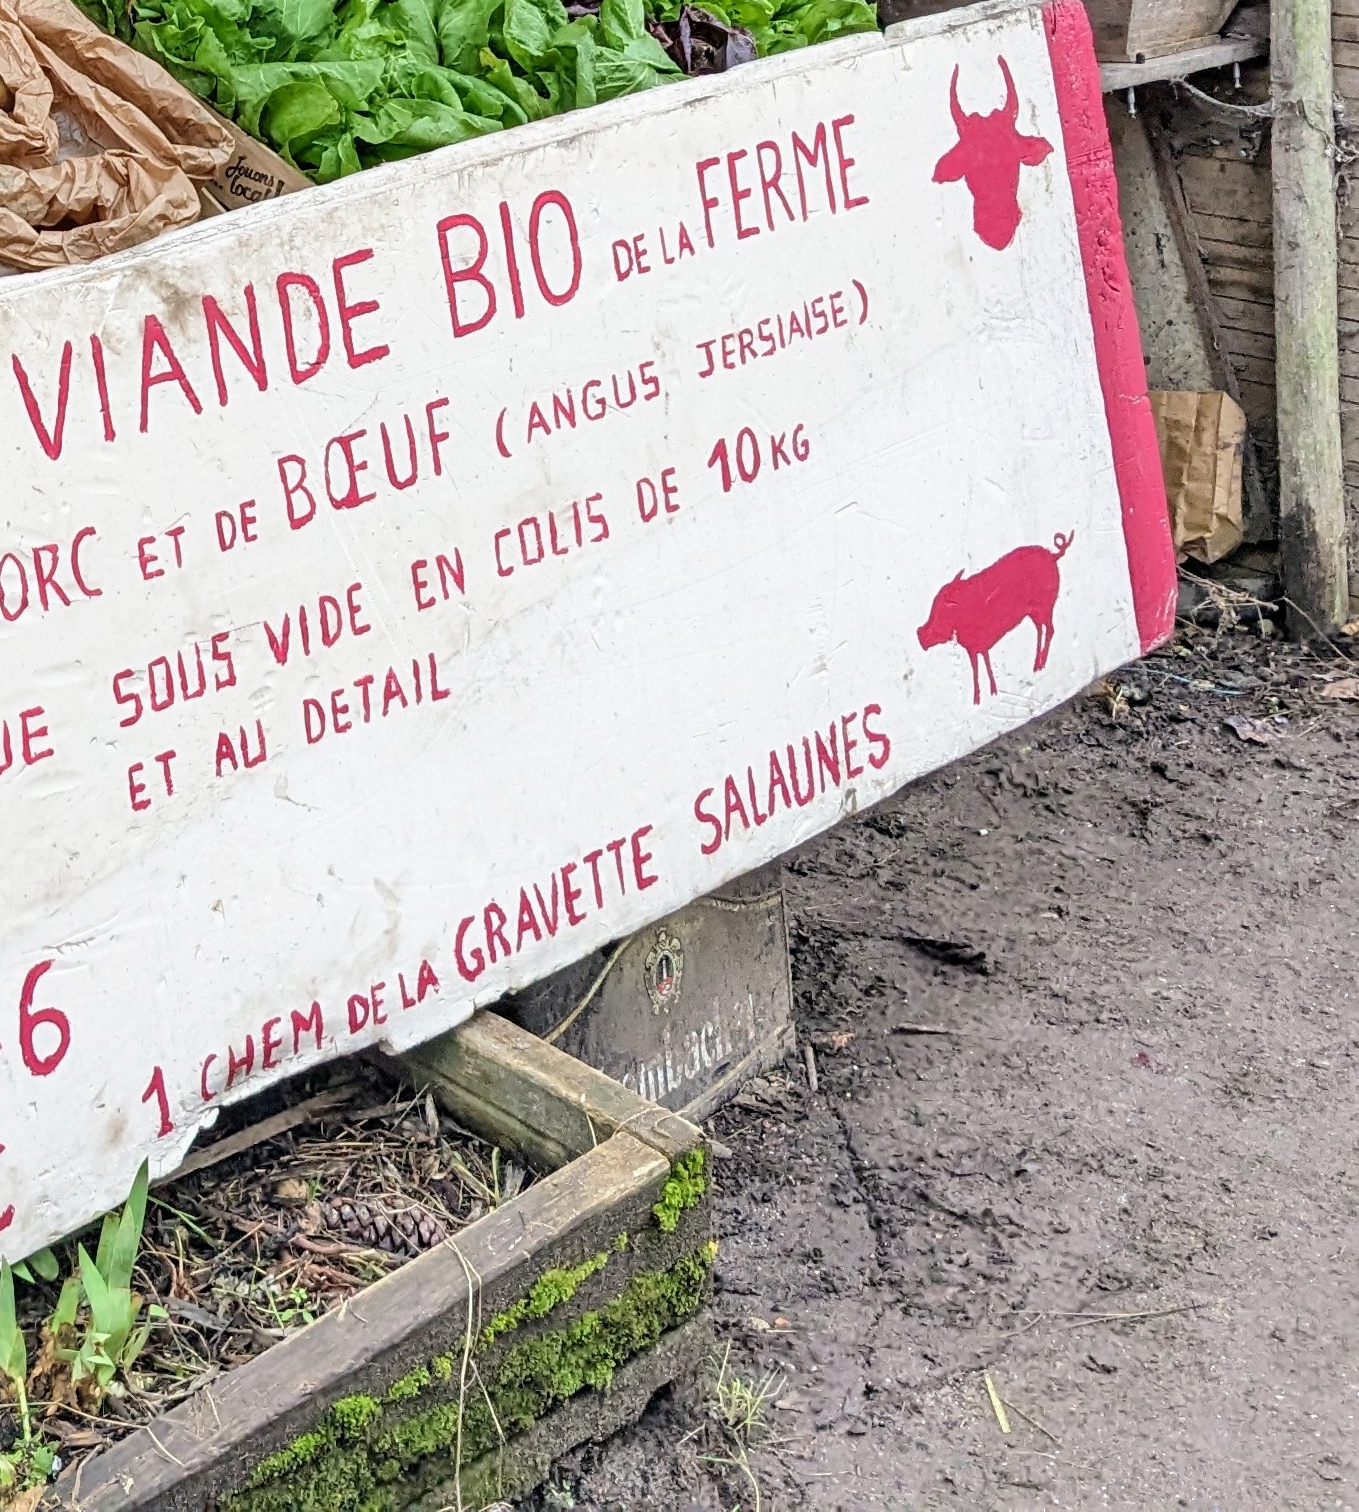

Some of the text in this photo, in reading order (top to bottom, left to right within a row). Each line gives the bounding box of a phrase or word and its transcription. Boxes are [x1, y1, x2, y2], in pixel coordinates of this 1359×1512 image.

[225, 155, 274, 187] Jouons
[12, 248, 390, 460] VIANDE
[437, 190, 582, 338] BIO
[612, 234, 651, 282] DE
[660, 220, 695, 265] LA
[696, 114, 869, 248] FERME
[113, 632, 237, 728] SOUS
[264, 582, 371, 666] VIDE
[411, 546, 466, 612] EN
[494, 492, 610, 578] COLIS
[636, 466, 681, 523] DE
[137, 525, 185, 581] ET
[215, 499, 258, 553] DE
[278, 397, 451, 531] BŒUF
[128, 652, 452, 812] ET AU DETAIL
[141, 1065, 174, 1138] 1
[347, 981, 389, 1035] DE
[398, 959, 442, 1010] LA
[454, 824, 661, 983] GRAVETTE
[694, 702, 892, 856] SALAUNES
